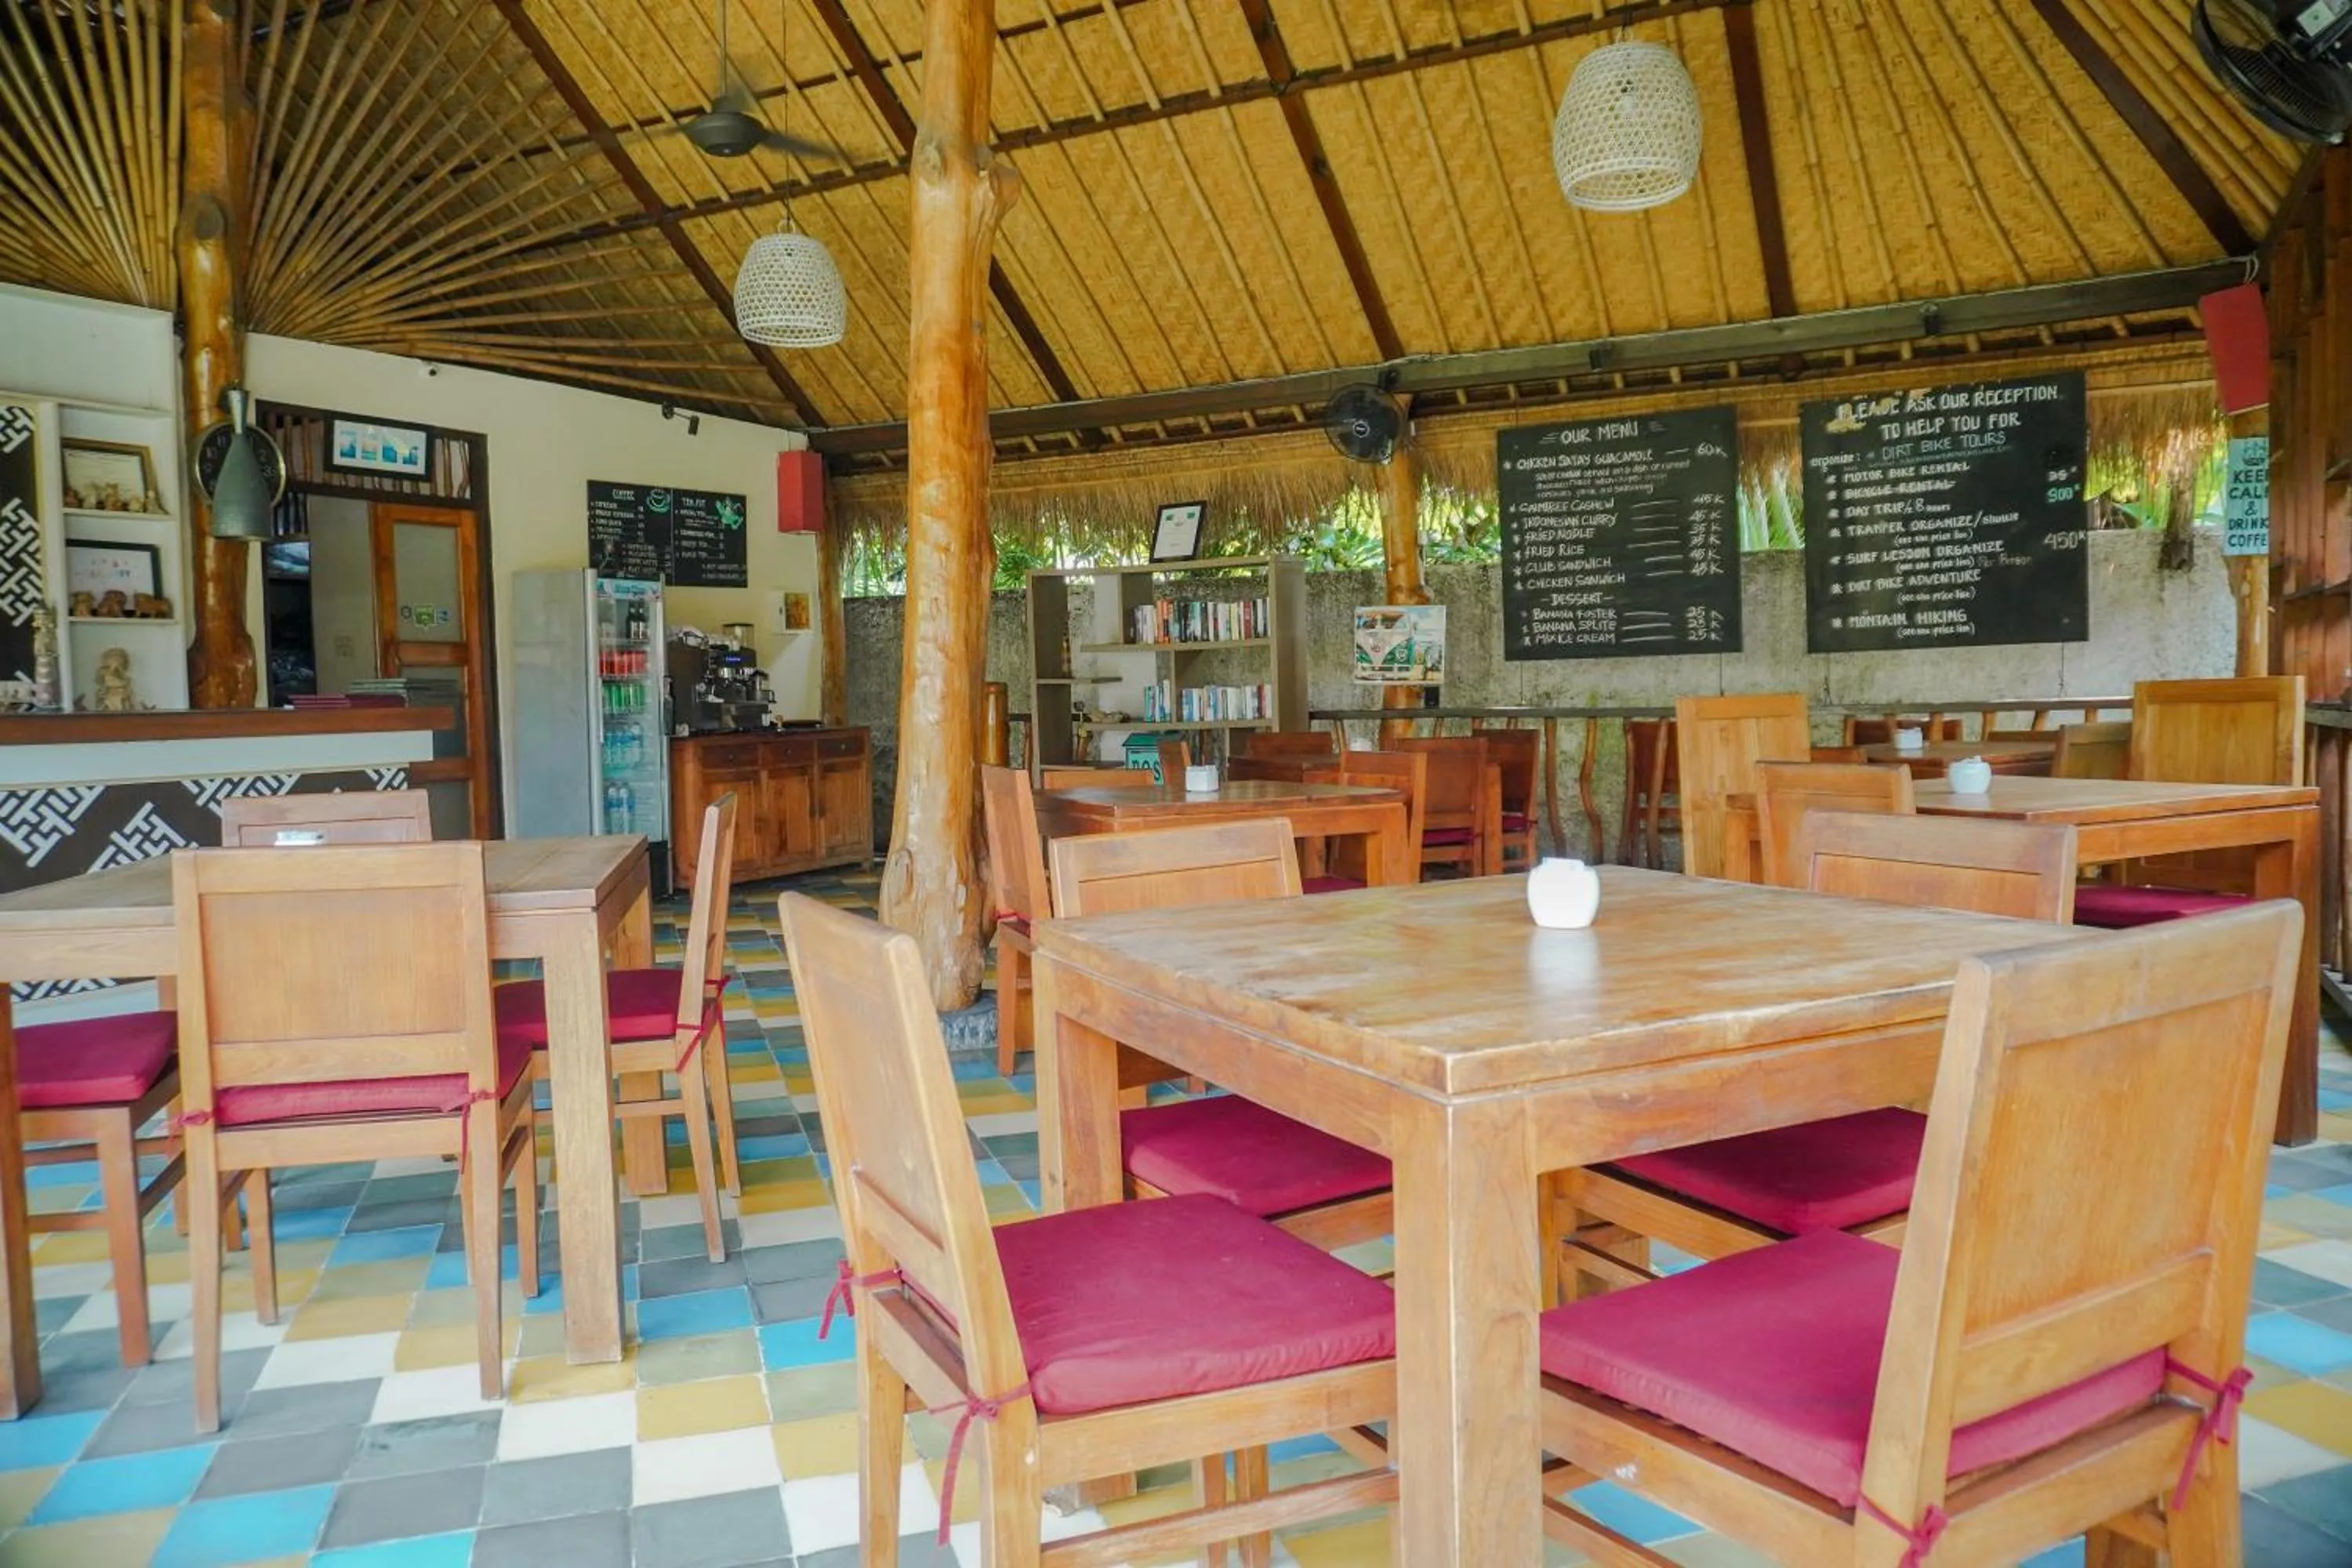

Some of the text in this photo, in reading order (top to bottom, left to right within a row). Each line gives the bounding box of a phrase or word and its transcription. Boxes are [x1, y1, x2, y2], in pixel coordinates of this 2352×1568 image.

[1905, 395, 1936, 413] ASK
[1940, 393, 1970, 411] OUR
[1973, 385, 2058, 407] RECEPTION
[1560, 420, 1639, 445] OUR MENU
[1880, 412, 2023, 441] TO HELP YOU FOR
[1882, 442, 1915, 461] DIRT
[1921, 437, 1952, 453] BIKE
[1959, 430, 2007, 449] TOURS
[1842, 470, 1885, 484] MOTOR
[1889, 466, 1916, 479] BIKE
[1920, 462, 1971, 476] RENTAL
[2233, 469, 2269, 484] KEE
[1581, 512, 1619, 528] CURRY
[1844, 506, 1871, 520] DAY
[2228, 517, 2269, 531] DRINK
[1557, 543, 1585, 557] RICE
[1846, 551, 1878, 564] SURF
[1883, 546, 1931, 561] LESSON
[1936, 539, 2005, 557] ORGANIZE
[1875, 575, 1904, 590] BIKE
[1908, 568, 1982, 586] ADVENTURE
[1551, 592, 1603, 606] DESSERT
[1532, 608, 1574, 622] BANANA
[1914, 608, 1968, 625] HIKING
[1531, 620, 1577, 634] BANANA
